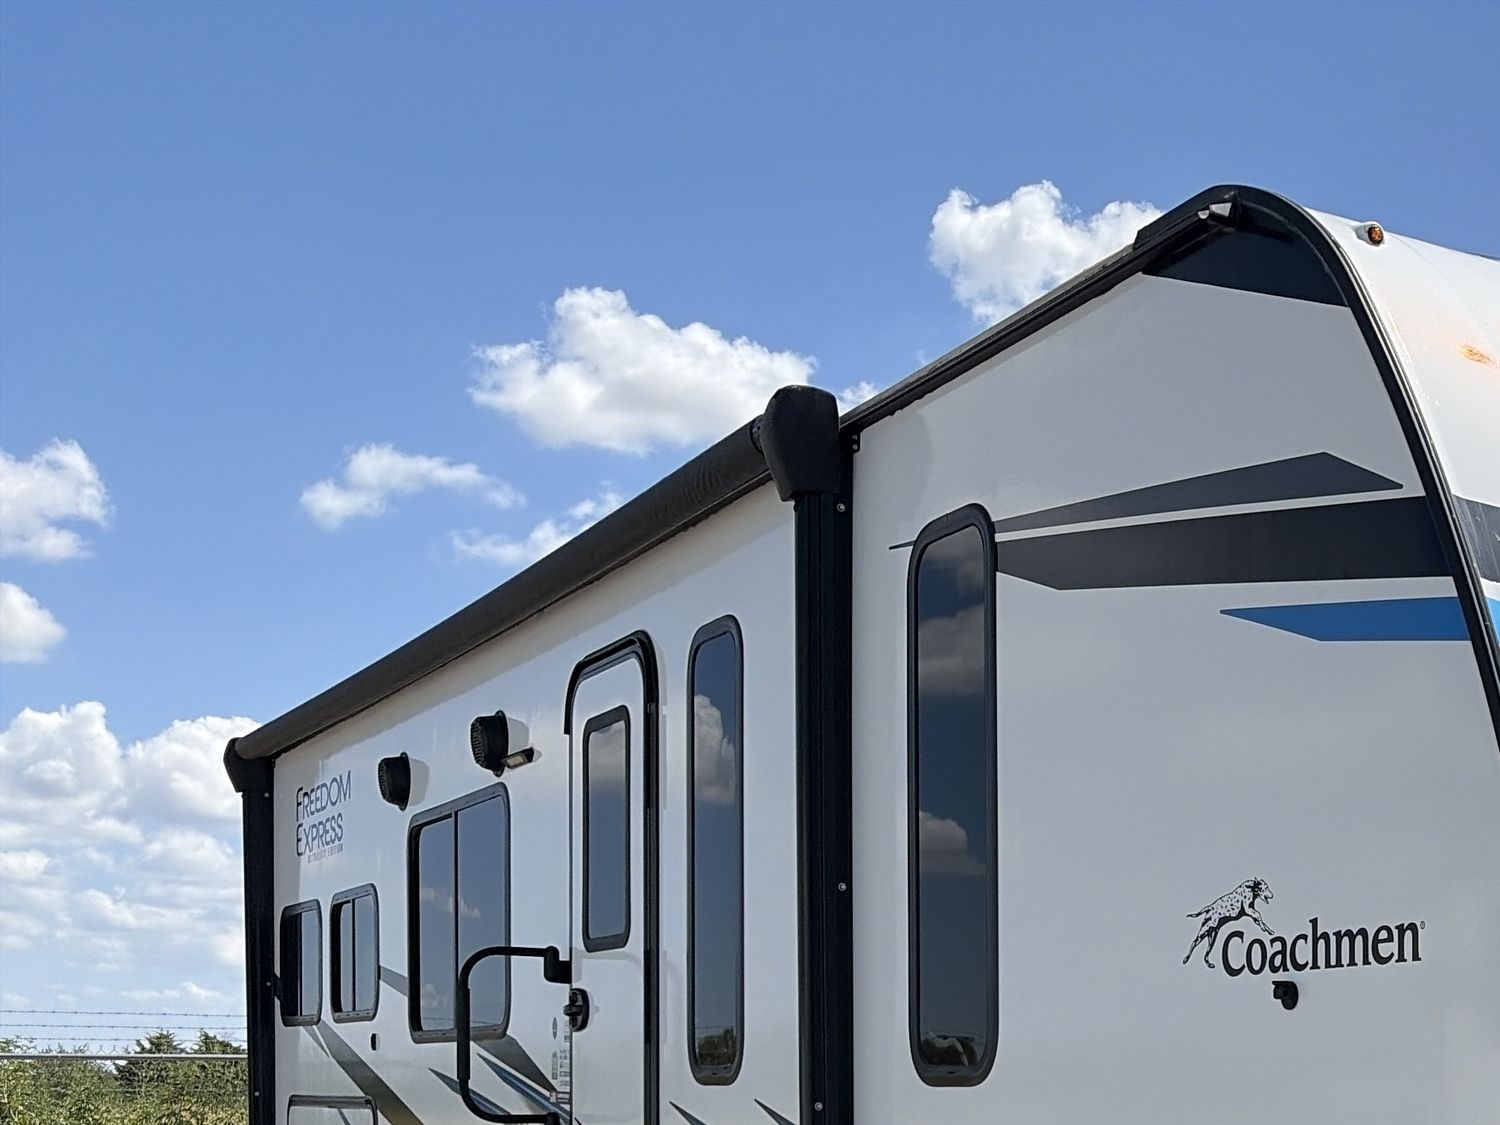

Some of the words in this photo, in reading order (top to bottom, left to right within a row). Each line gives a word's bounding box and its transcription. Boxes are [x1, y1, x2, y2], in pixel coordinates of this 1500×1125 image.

[296, 769, 351, 822] FREEDOM
[296, 812, 344, 857] EXPRESS
[1221, 916, 1423, 978] Coachmen
